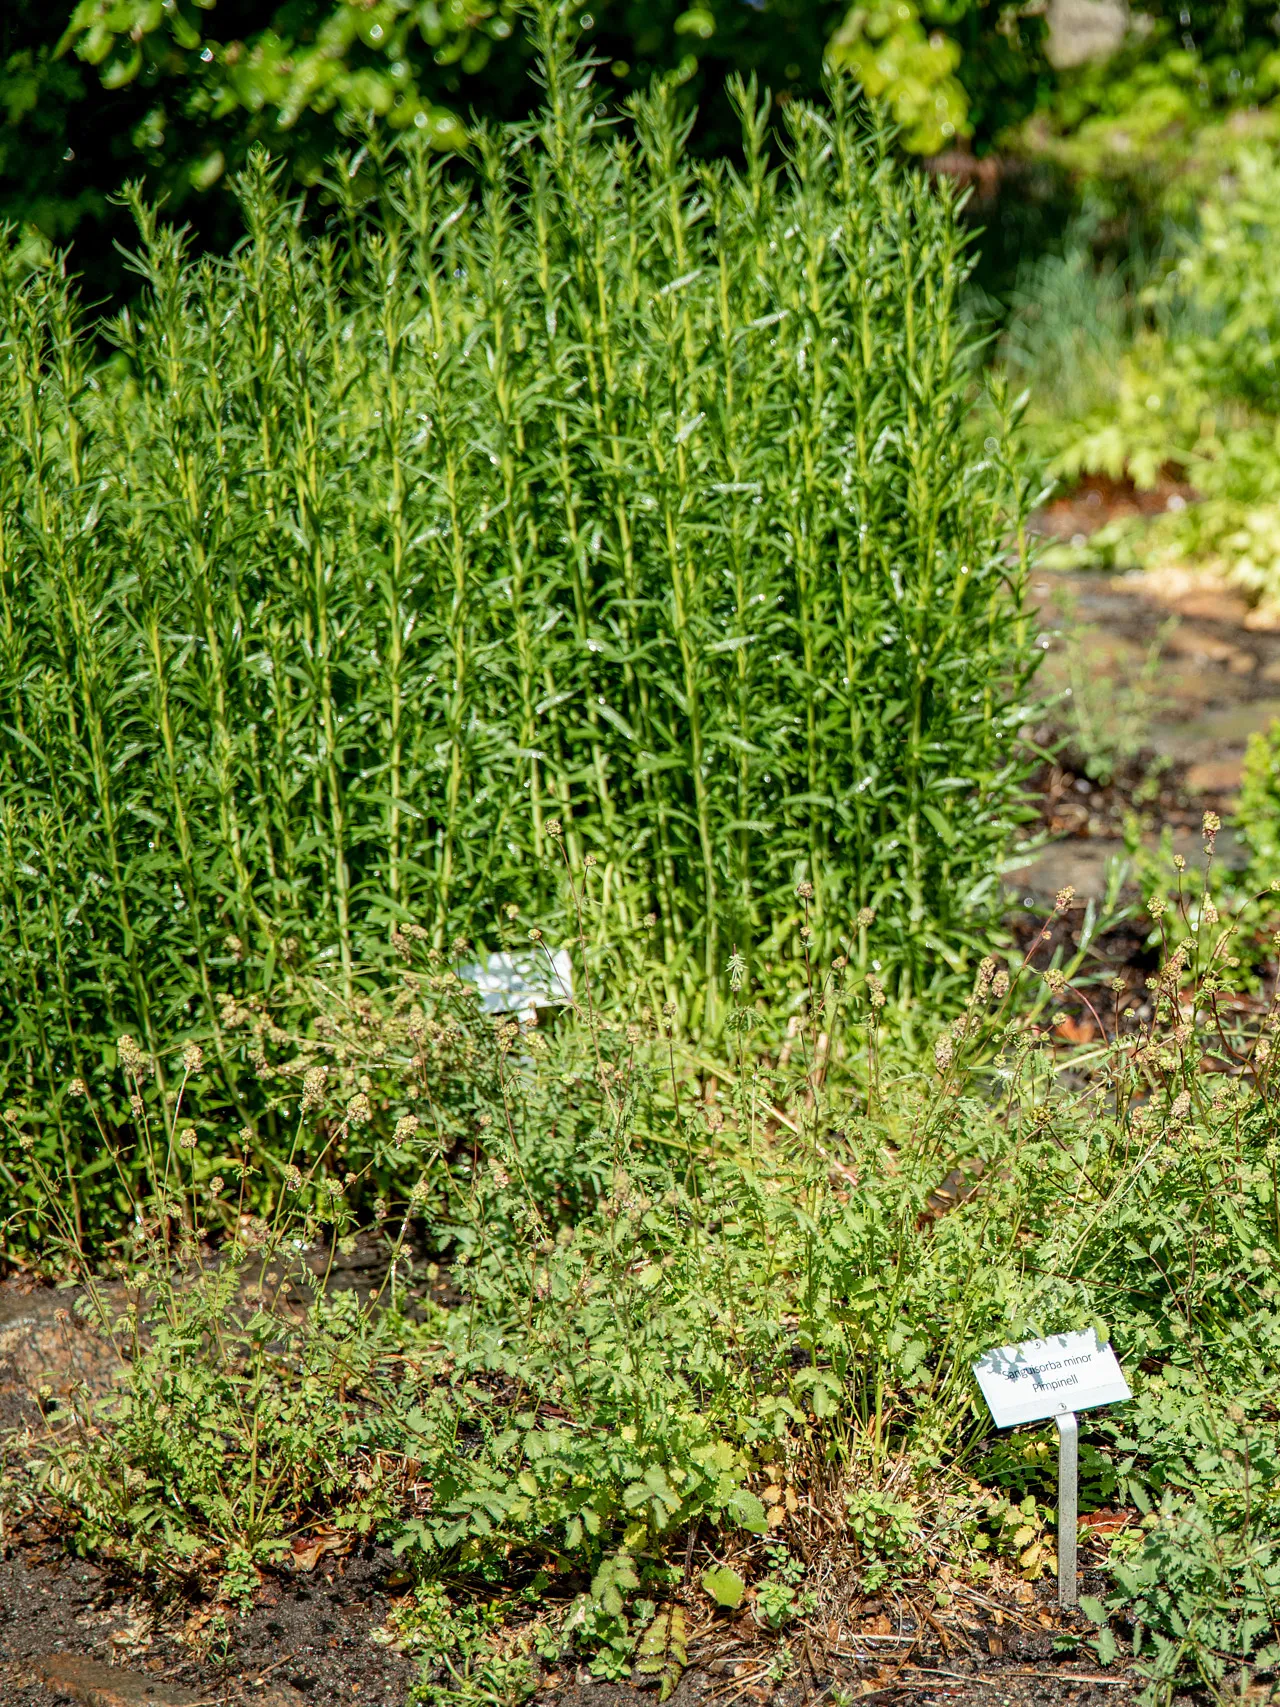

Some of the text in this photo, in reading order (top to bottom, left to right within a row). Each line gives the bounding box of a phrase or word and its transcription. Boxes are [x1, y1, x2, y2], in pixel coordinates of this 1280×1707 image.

[1002, 1353, 1092, 1380] Sanguisorba minor
[1032, 1375, 1079, 1393] Pimpinell
